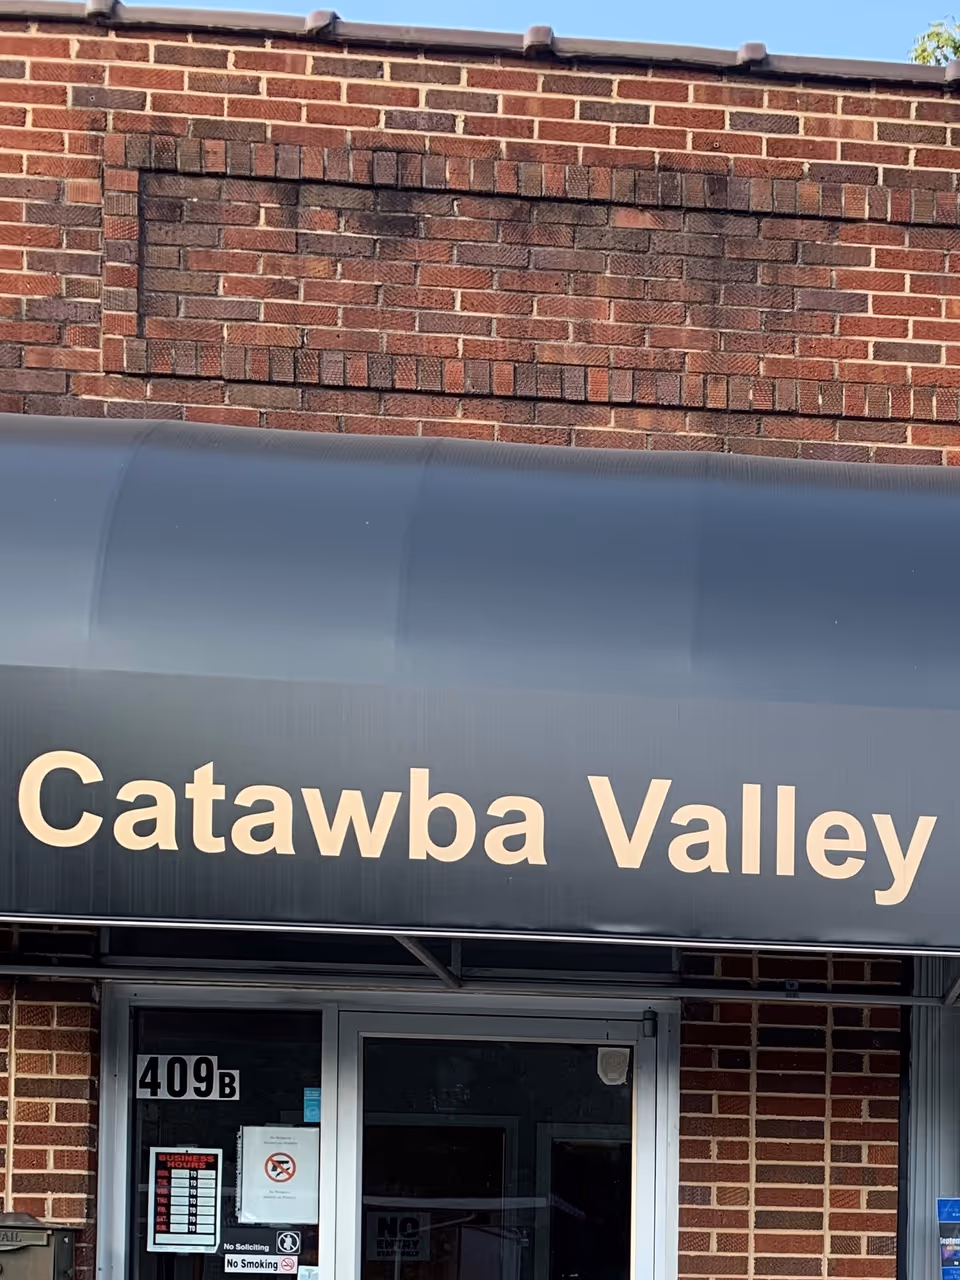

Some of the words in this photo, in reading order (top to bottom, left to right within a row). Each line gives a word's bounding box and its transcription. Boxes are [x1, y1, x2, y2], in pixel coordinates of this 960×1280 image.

[16, 750, 547, 866] Catawba
[587, 774, 938, 906] Valley
[158, 1154, 215, 1163] BUSINESS
[166, 1161, 206, 1169] HOURS
[377, 1216, 420, 1238] NO
[235, 1243, 270, 1252] Soliciting
[227, 1258, 239, 1268] No
[240, 1258, 278, 1271] Smoking
